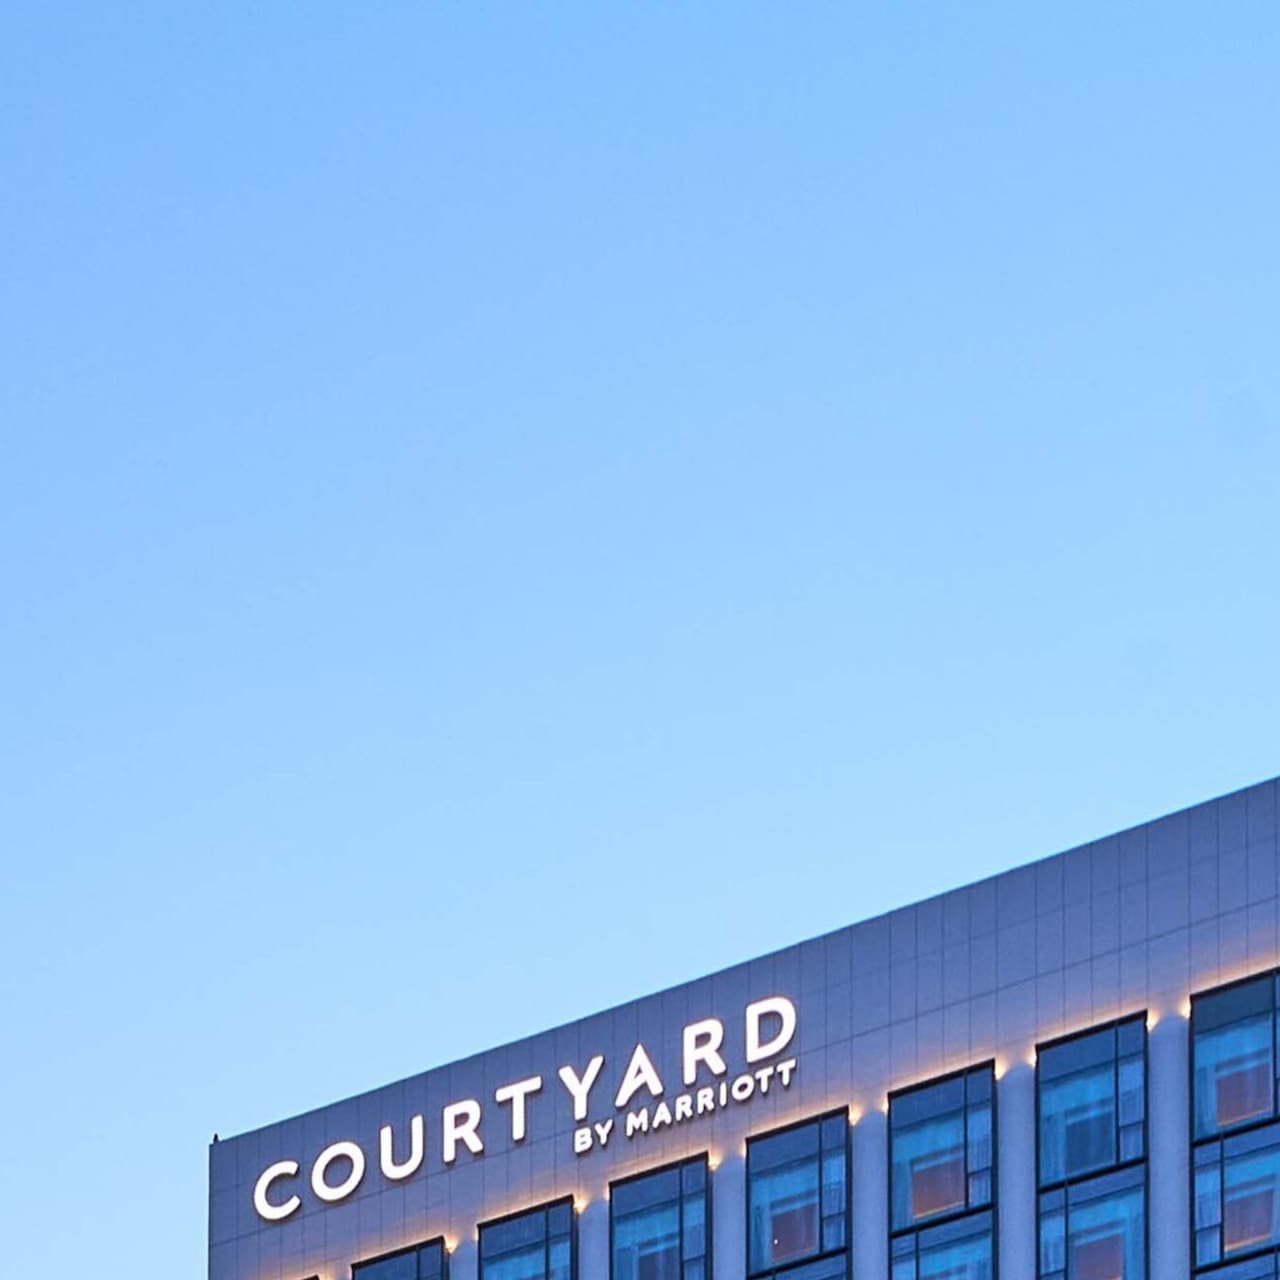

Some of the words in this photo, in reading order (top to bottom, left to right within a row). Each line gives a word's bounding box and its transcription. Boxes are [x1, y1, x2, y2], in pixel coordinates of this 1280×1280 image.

[252, 995, 797, 1221] COURTYARD
[573, 1118, 614, 1154] BY
[625, 1058, 797, 1137] MARRIOTT
